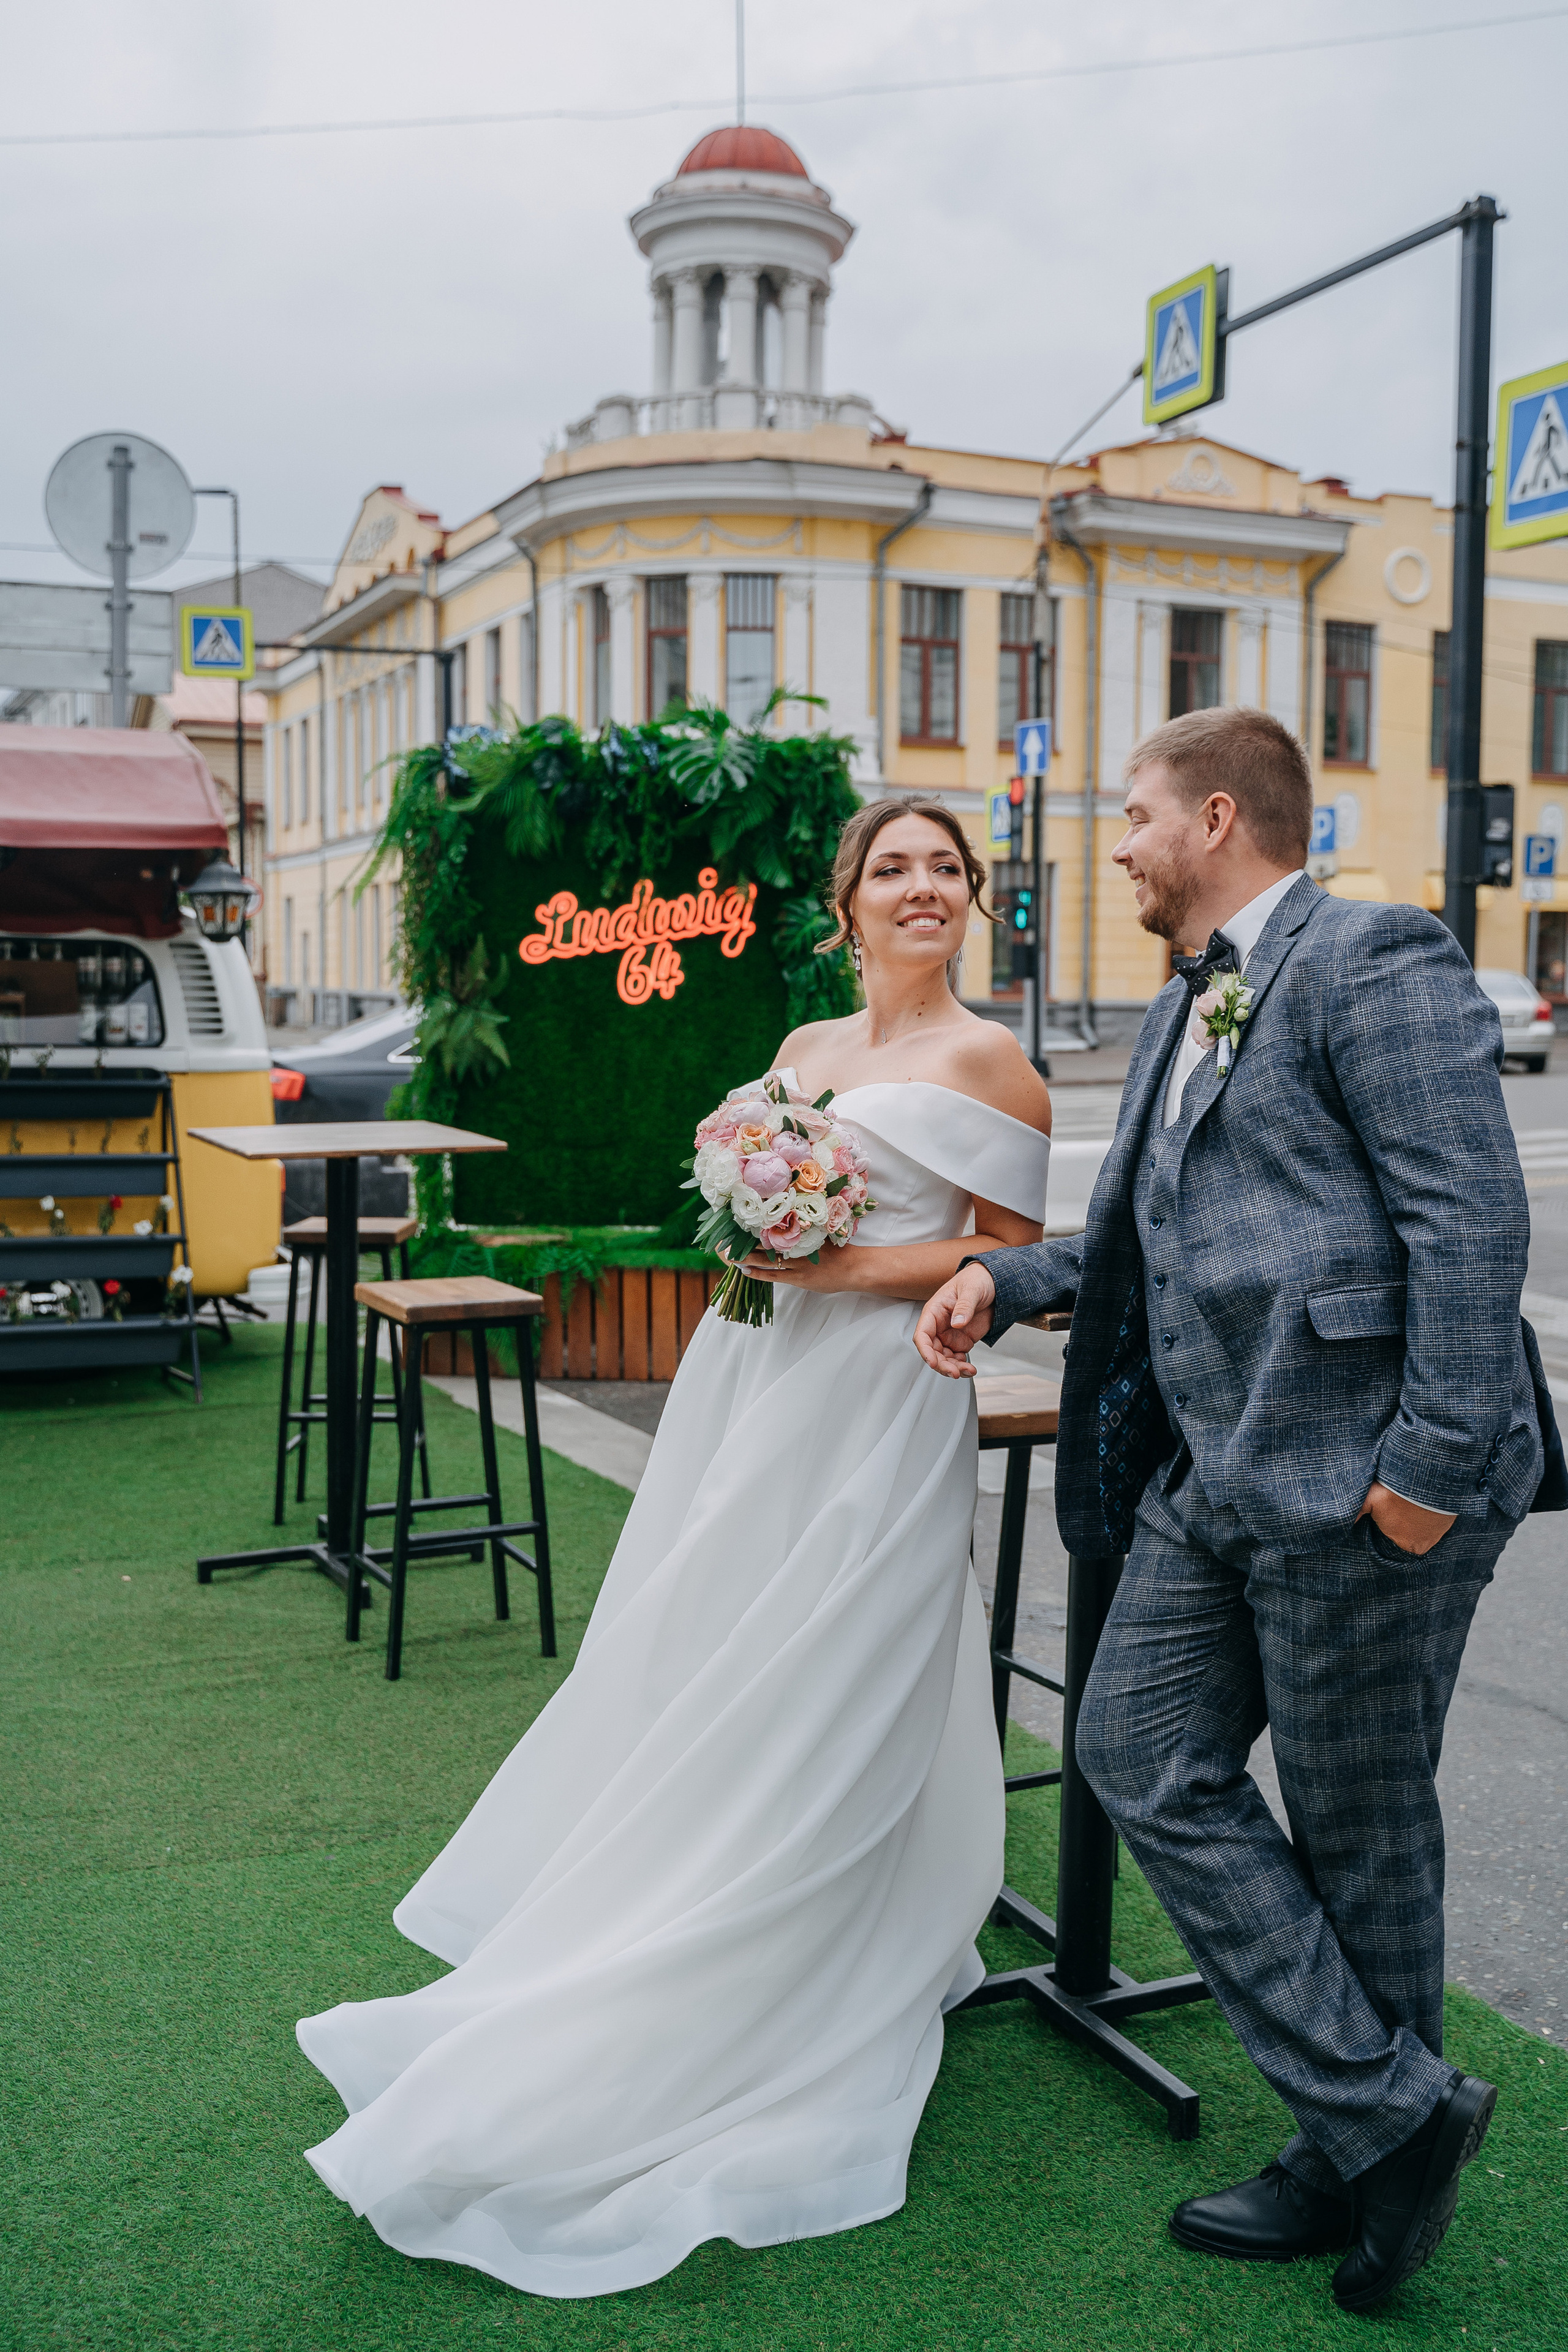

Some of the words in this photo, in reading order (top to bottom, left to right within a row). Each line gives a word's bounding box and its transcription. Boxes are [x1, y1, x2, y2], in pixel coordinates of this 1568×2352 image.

[1531, 839, 1554, 873] P
[519, 867, 758, 964] Ludwig
[617, 941, 684, 1005] 64
